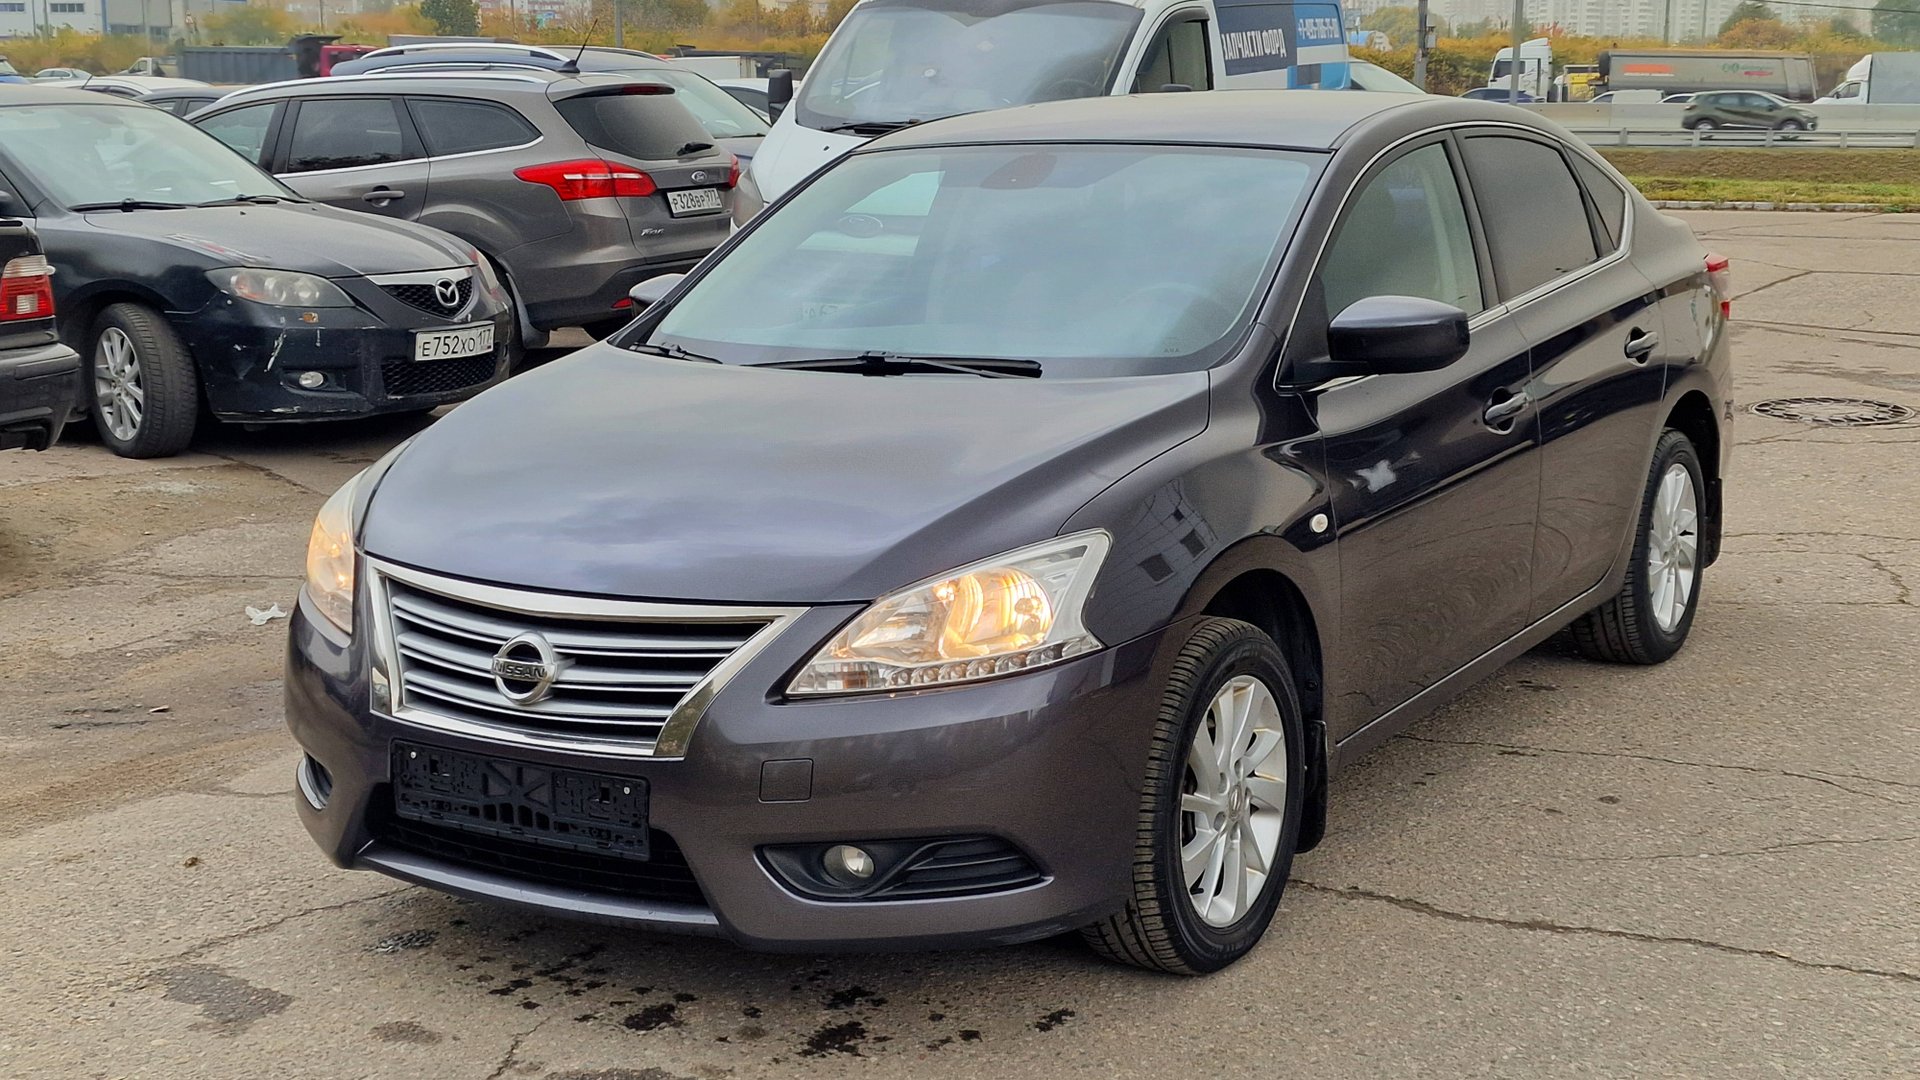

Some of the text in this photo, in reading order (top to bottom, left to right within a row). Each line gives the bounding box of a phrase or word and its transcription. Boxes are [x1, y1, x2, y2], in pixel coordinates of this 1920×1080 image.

[1221, 30, 1264, 60] ЗАПЧАСТИ
[1262, 28, 1287, 58] ФОРД
[494, 659, 546, 680] NISSAN
